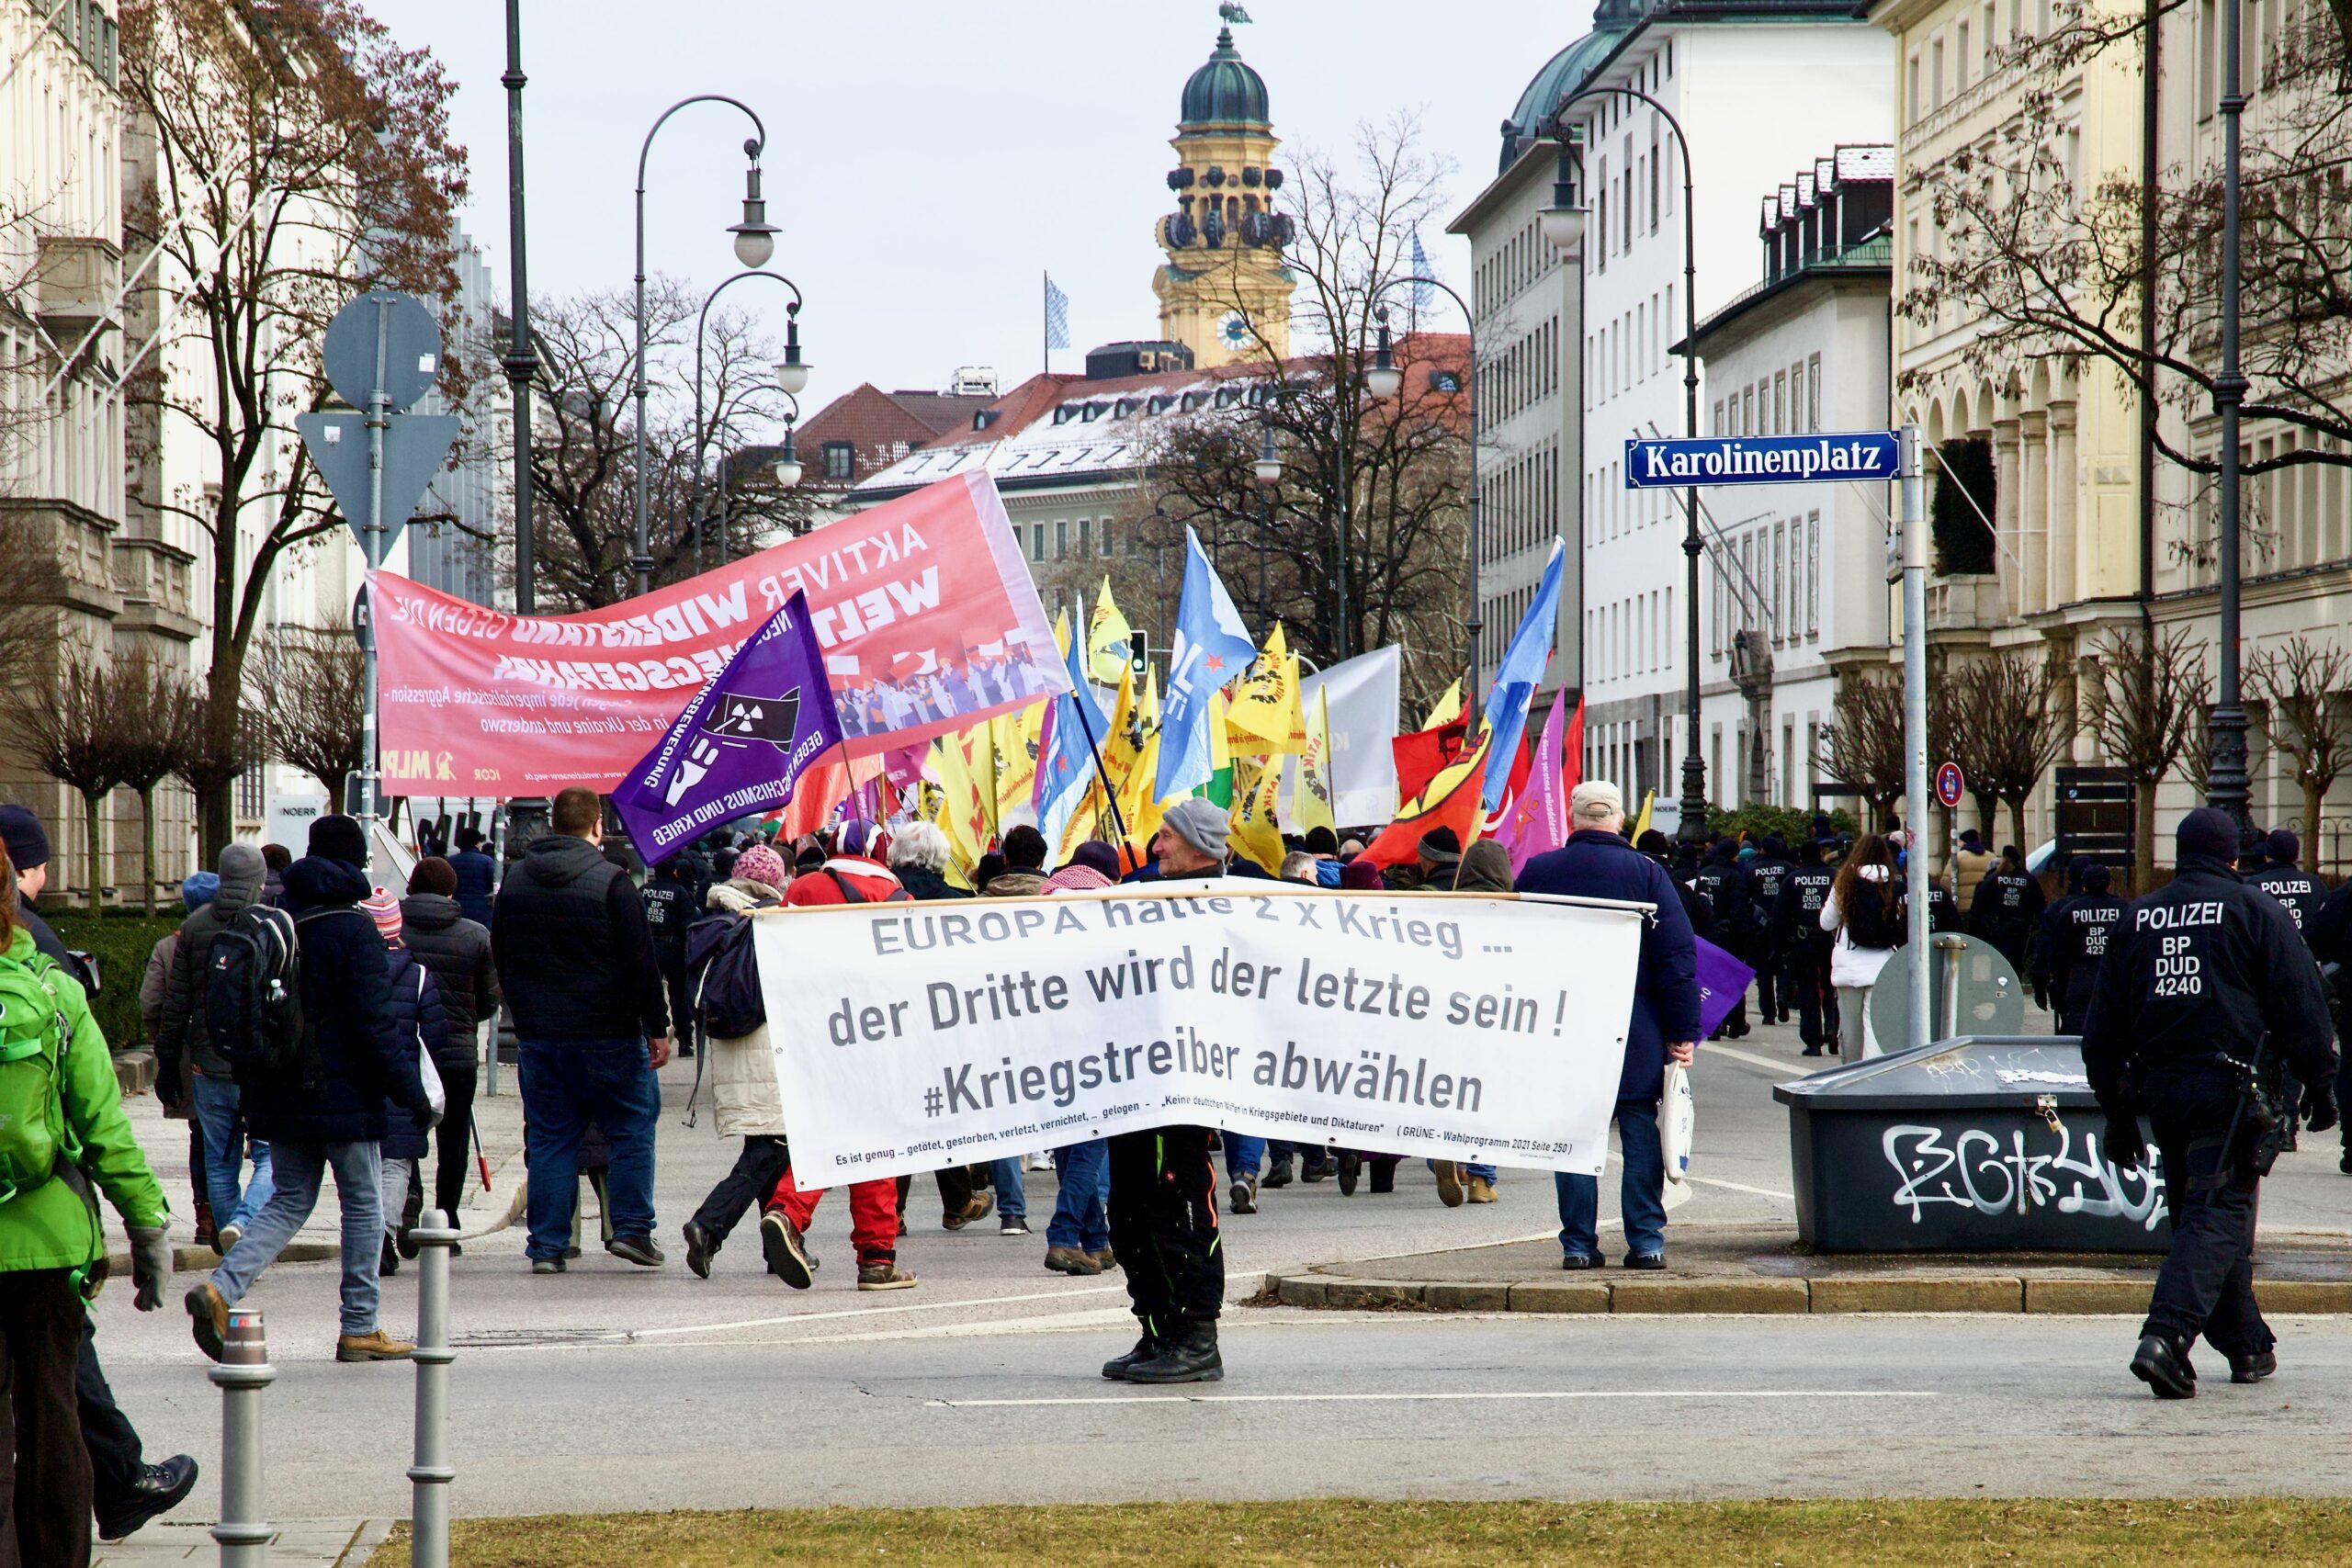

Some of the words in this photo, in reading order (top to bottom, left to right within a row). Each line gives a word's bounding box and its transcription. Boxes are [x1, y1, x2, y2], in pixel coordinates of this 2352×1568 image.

[1645, 440, 1882, 479] Karolinenplatz
[282, 807, 316, 817] NOERR
[1755, 865, 1785, 876] POLIZEI
[1794, 875, 1829, 886] POLIZEI
[1997, 875, 2027, 886] POLIZEI
[2261, 880, 2312, 895] POLIZEI
[642, 887, 674, 901] POLIZEI
[1805, 887, 1818, 896] BP
[2073, 908, 2120, 923] POLIZEI
[2136, 902, 2223, 931] POLIZEI
[871, 906, 1088, 956] EUROPA
[1250, 896, 1280, 922] 2
[1295, 901, 1323, 931] x
[1334, 898, 1464, 960] Krieg
[2089, 927, 2105, 936] BP
[2086, 945, 2104, 955] 423
[2163, 936, 2191, 955] BP
[2155, 956, 2200, 977] DUD
[2154, 976, 2201, 997] 4240
[828, 997, 909, 1047] der
[925, 970, 1069, 1032] Dritte
[1085, 944, 1194, 1003] wird
[1210, 946, 1282, 999] der
[1296, 957, 1430, 1021] letzte
[1446, 984, 1539, 1037] sein
[923, 1026, 1240, 1119] #Kriegstreiber
[1252, 1040, 1484, 1112] abwählen
[835, 1155, 848, 1166] Es
[850, 1153, 862, 1163] ist
[865, 1148, 895, 1163] genug
[907, 1140, 944, 1156] getötet,
[946, 1132, 998, 1150] gestorben,
[1000, 1123, 1039, 1139] verletzt,
[1040, 1111, 1089, 1130] vernichtet,
[1102, 1102, 1140, 1119] gelogen
[1193, 1096, 1224, 1110] deutschen
[1249, 1106, 1308, 1123] Kriegsgebiete
[1310, 1117, 1329, 1126] und
[1403, 1124, 1435, 1139] GRÜNE
[1443, 1131, 1510, 1149] Wahlprogramm
[1512, 1139, 1530, 1150] 2021
[1532, 1140, 1551, 1152] Seite
[1553, 1143, 1568, 1154] 250
